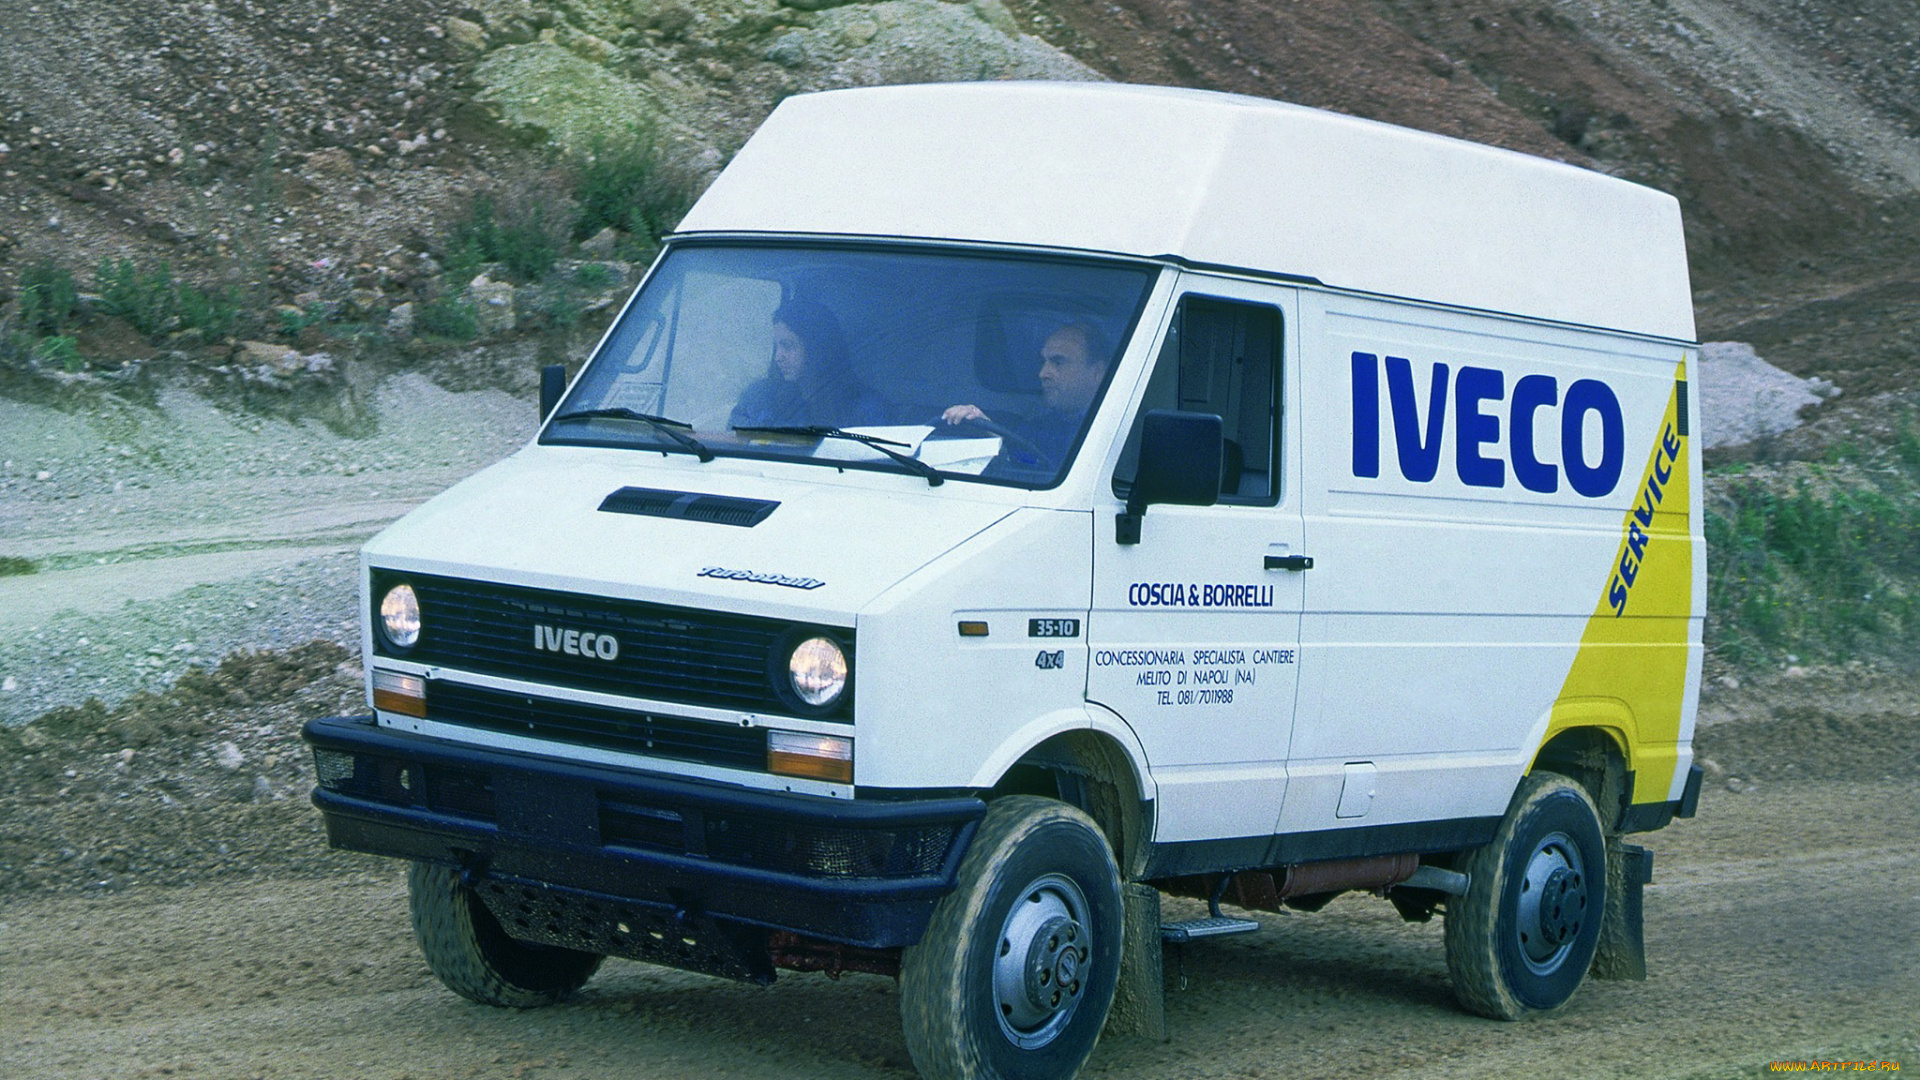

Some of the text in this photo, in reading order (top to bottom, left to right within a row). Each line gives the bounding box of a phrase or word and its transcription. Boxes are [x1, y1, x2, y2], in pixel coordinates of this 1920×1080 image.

[1351, 351, 1625, 498] IVECO
[1609, 422, 1681, 618] SERVICE
[697, 566, 826, 590] TurboDaily
[1129, 583, 1274, 607] COSCIA & BORRELLI
[534, 624, 619, 661] IVECO
[1095, 650, 1294, 666] CONCESSIONARIA SPECIALISTA CANTIERE
[1136, 668, 1256, 686] MELITO DI NAPOLI (NA)
[1157, 689, 1234, 706] TEL. 081/7011988
